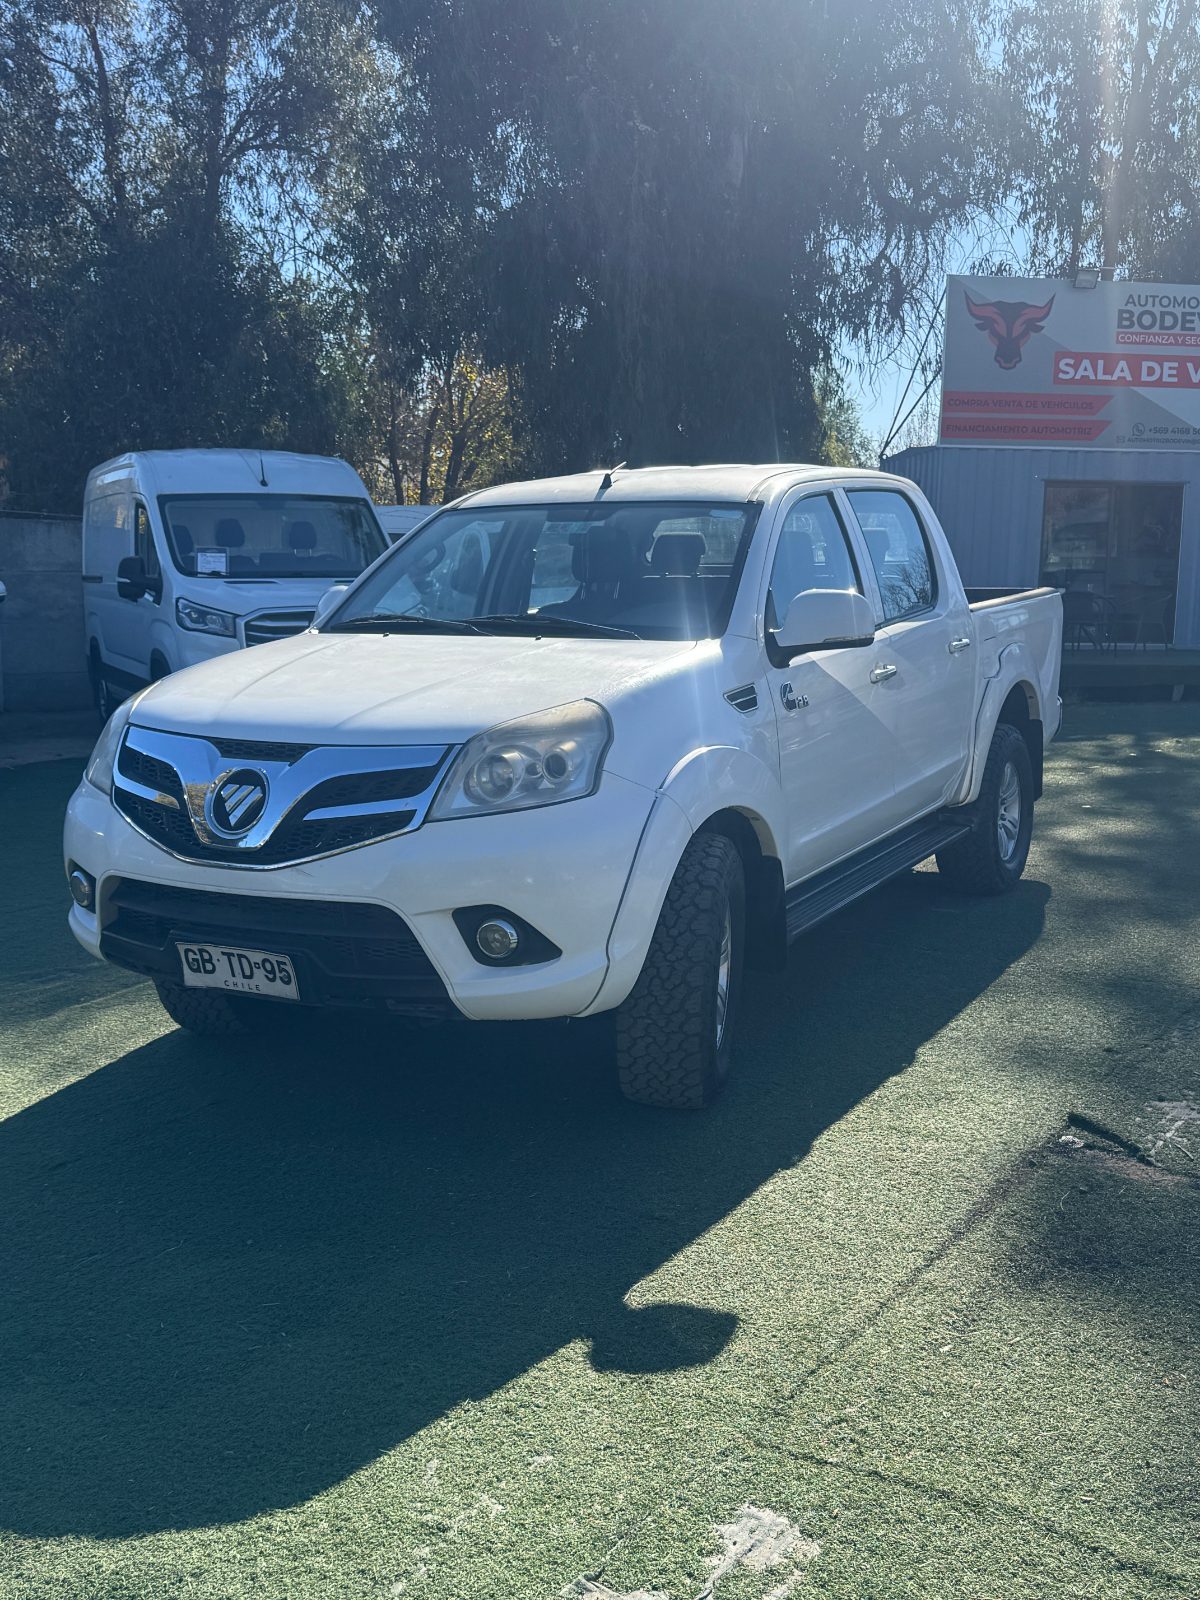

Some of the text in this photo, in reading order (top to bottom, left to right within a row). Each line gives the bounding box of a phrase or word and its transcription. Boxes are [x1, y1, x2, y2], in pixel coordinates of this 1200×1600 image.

[1117, 308, 1200, 332] BODE
[1118, 333, 1175, 344] CONFIANZA
[1176, 335, 1184, 344] Y
[1057, 358, 1133, 381] SALA
[1141, 361, 1178, 383] DE
[947, 398, 990, 408] COMPRA
[992, 399, 1023, 409] VENTA
[1025, 400, 1038, 409] DE
[946, 424, 1093, 436] FINANCIAMIENTO AUTOMOTRIZ
[224, 980, 261, 992] CHILE
